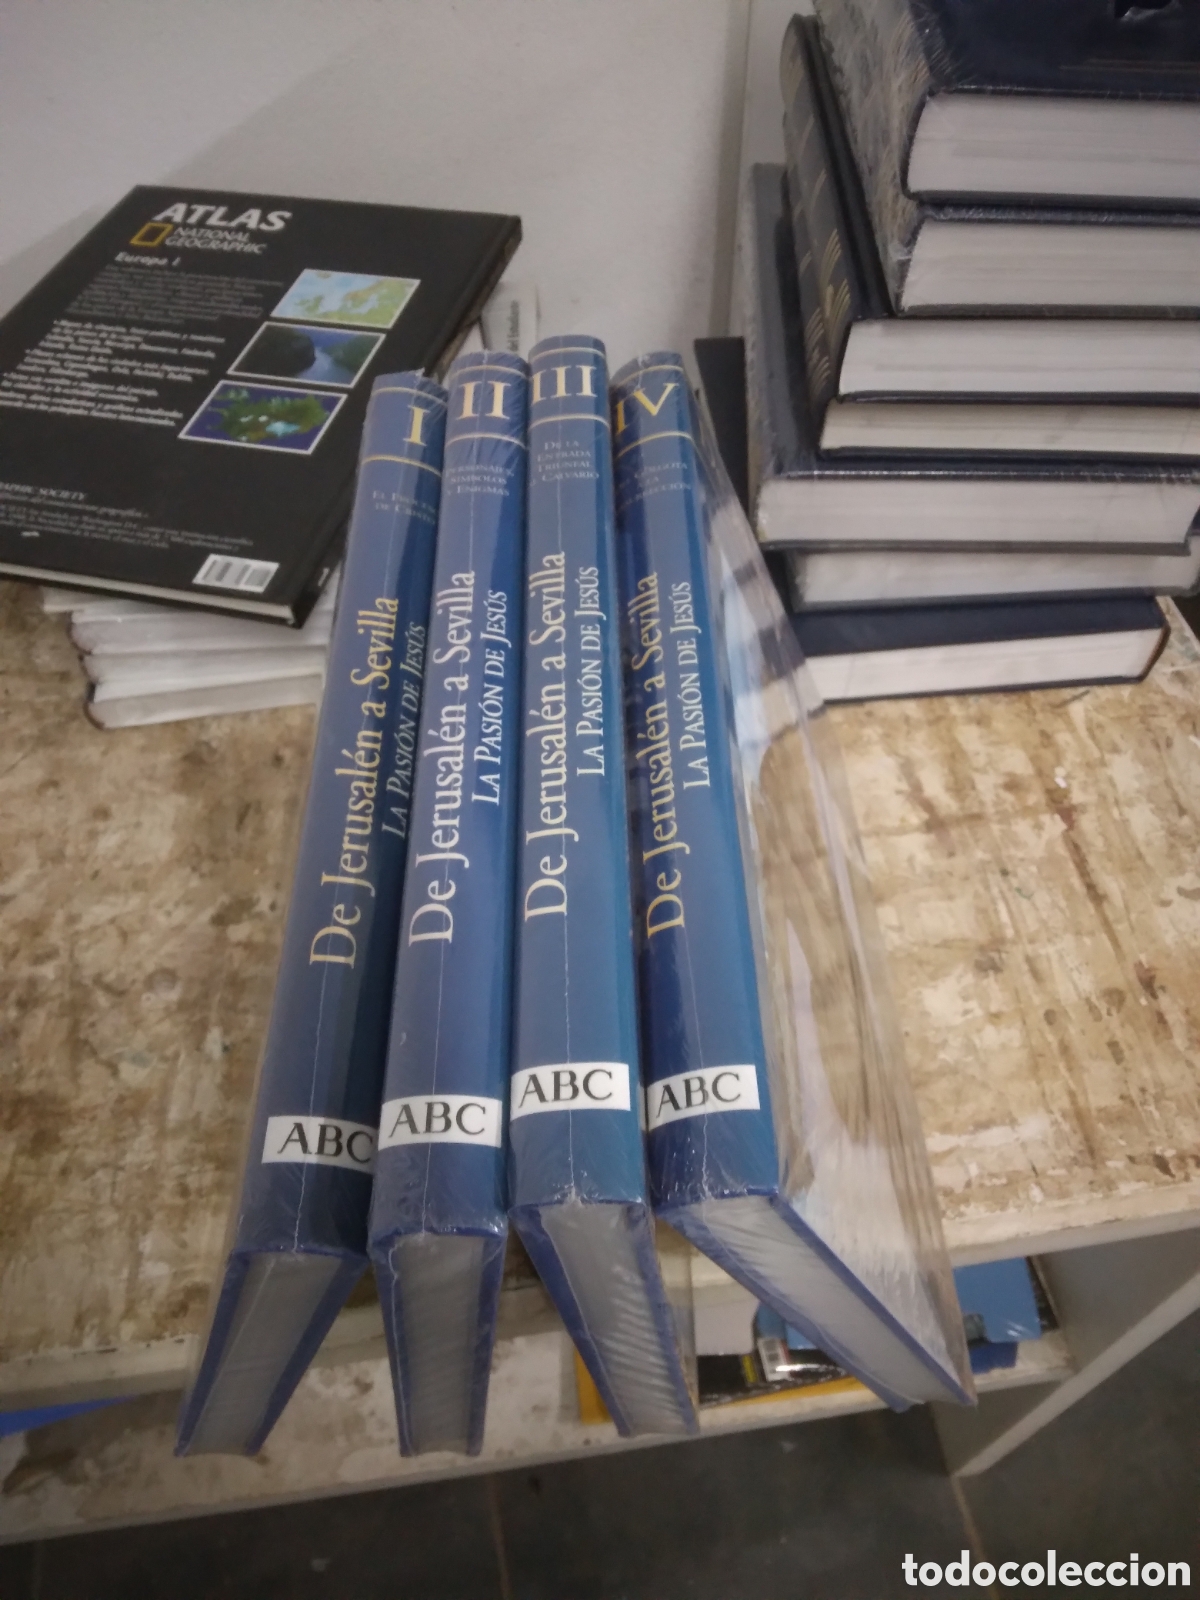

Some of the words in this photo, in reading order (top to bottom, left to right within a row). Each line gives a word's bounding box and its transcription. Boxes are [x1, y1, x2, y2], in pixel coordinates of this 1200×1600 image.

[150, 202, 293, 232] ATLAS
[173, 226, 250, 243] NATIONAL
[164, 236, 267, 255] GEOGRAPHIC
[456, 380, 511, 420] II
[531, 364, 599, 405] III
[403, 406, 430, 447] I
[615, 382, 680, 435] IV
[529, 551, 565, 645] Sevilla
[574, 565, 607, 621] JESÚS
[669, 581, 702, 634] JESÚS
[433, 570, 475, 664] Sevilla
[480, 589, 512, 648] JESÚS
[581, 623, 602, 655] DE
[628, 572, 664, 671] Sevilla
[350, 597, 399, 690] Sevilla
[483, 647, 505, 678] DE
[542, 653, 566, 671] a
[676, 637, 698, 666] DE
[443, 674, 469, 691] a
[576, 658, 604, 741] PASIÓN
[643, 672, 666, 690] a
[361, 701, 387, 718] a
[473, 682, 504, 766] PASIÓN
[679, 672, 706, 753] PASIÓN
[526, 681, 579, 845] Jerusalén
[576, 744, 606, 777] LA
[636, 698, 691, 865] Jerusalén
[683, 755, 711, 790] LA
[415, 703, 469, 868] Jerusalén
[471, 774, 500, 807] LA
[321, 730, 383, 897] Jerusalén
[524, 853, 568, 922] De
[646, 869, 685, 939] De
[309, 903, 361, 968] De
[408, 879, 457, 947] De
[518, 1068, 614, 1109] ABC
[655, 1072, 743, 1118] ABC
[277, 1121, 374, 1165] ABC
[388, 1101, 487, 1139] ABC
